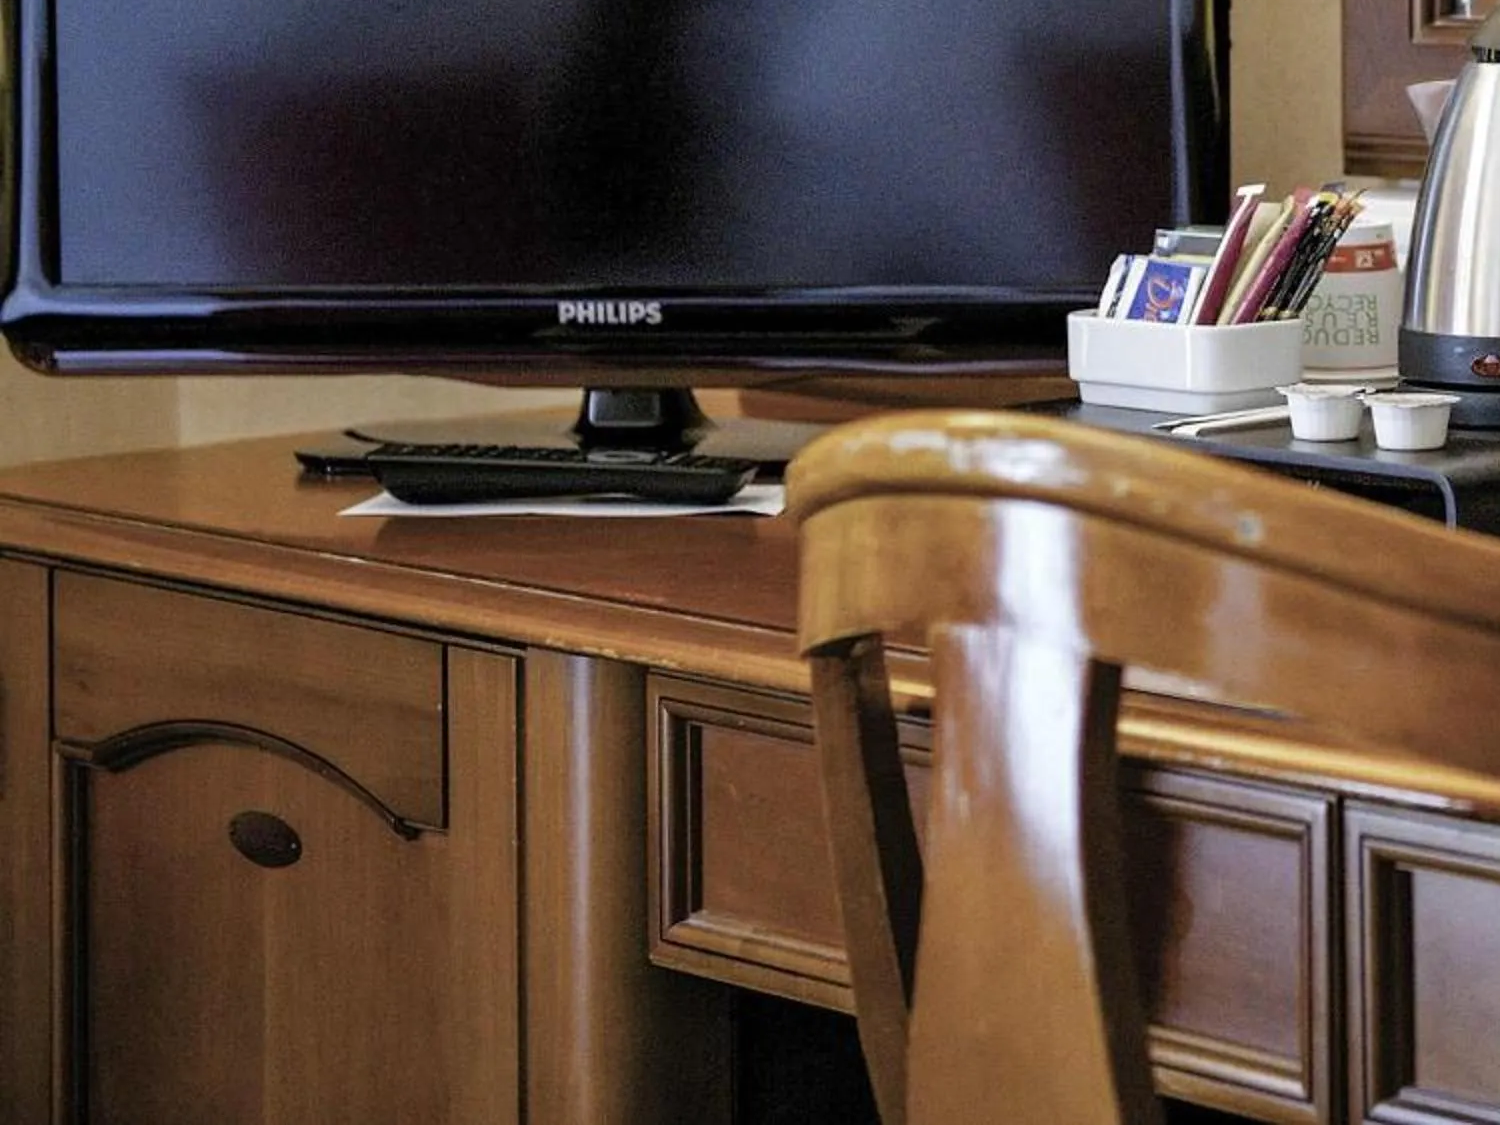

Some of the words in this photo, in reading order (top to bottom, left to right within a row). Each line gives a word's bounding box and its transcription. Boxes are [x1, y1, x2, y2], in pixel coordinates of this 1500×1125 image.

[1308, 293, 1378, 312] RECYC
[557, 300, 663, 325] PHILIPS
[1304, 311, 1378, 329] REUS
[1303, 328, 1379, 346] REDUC
